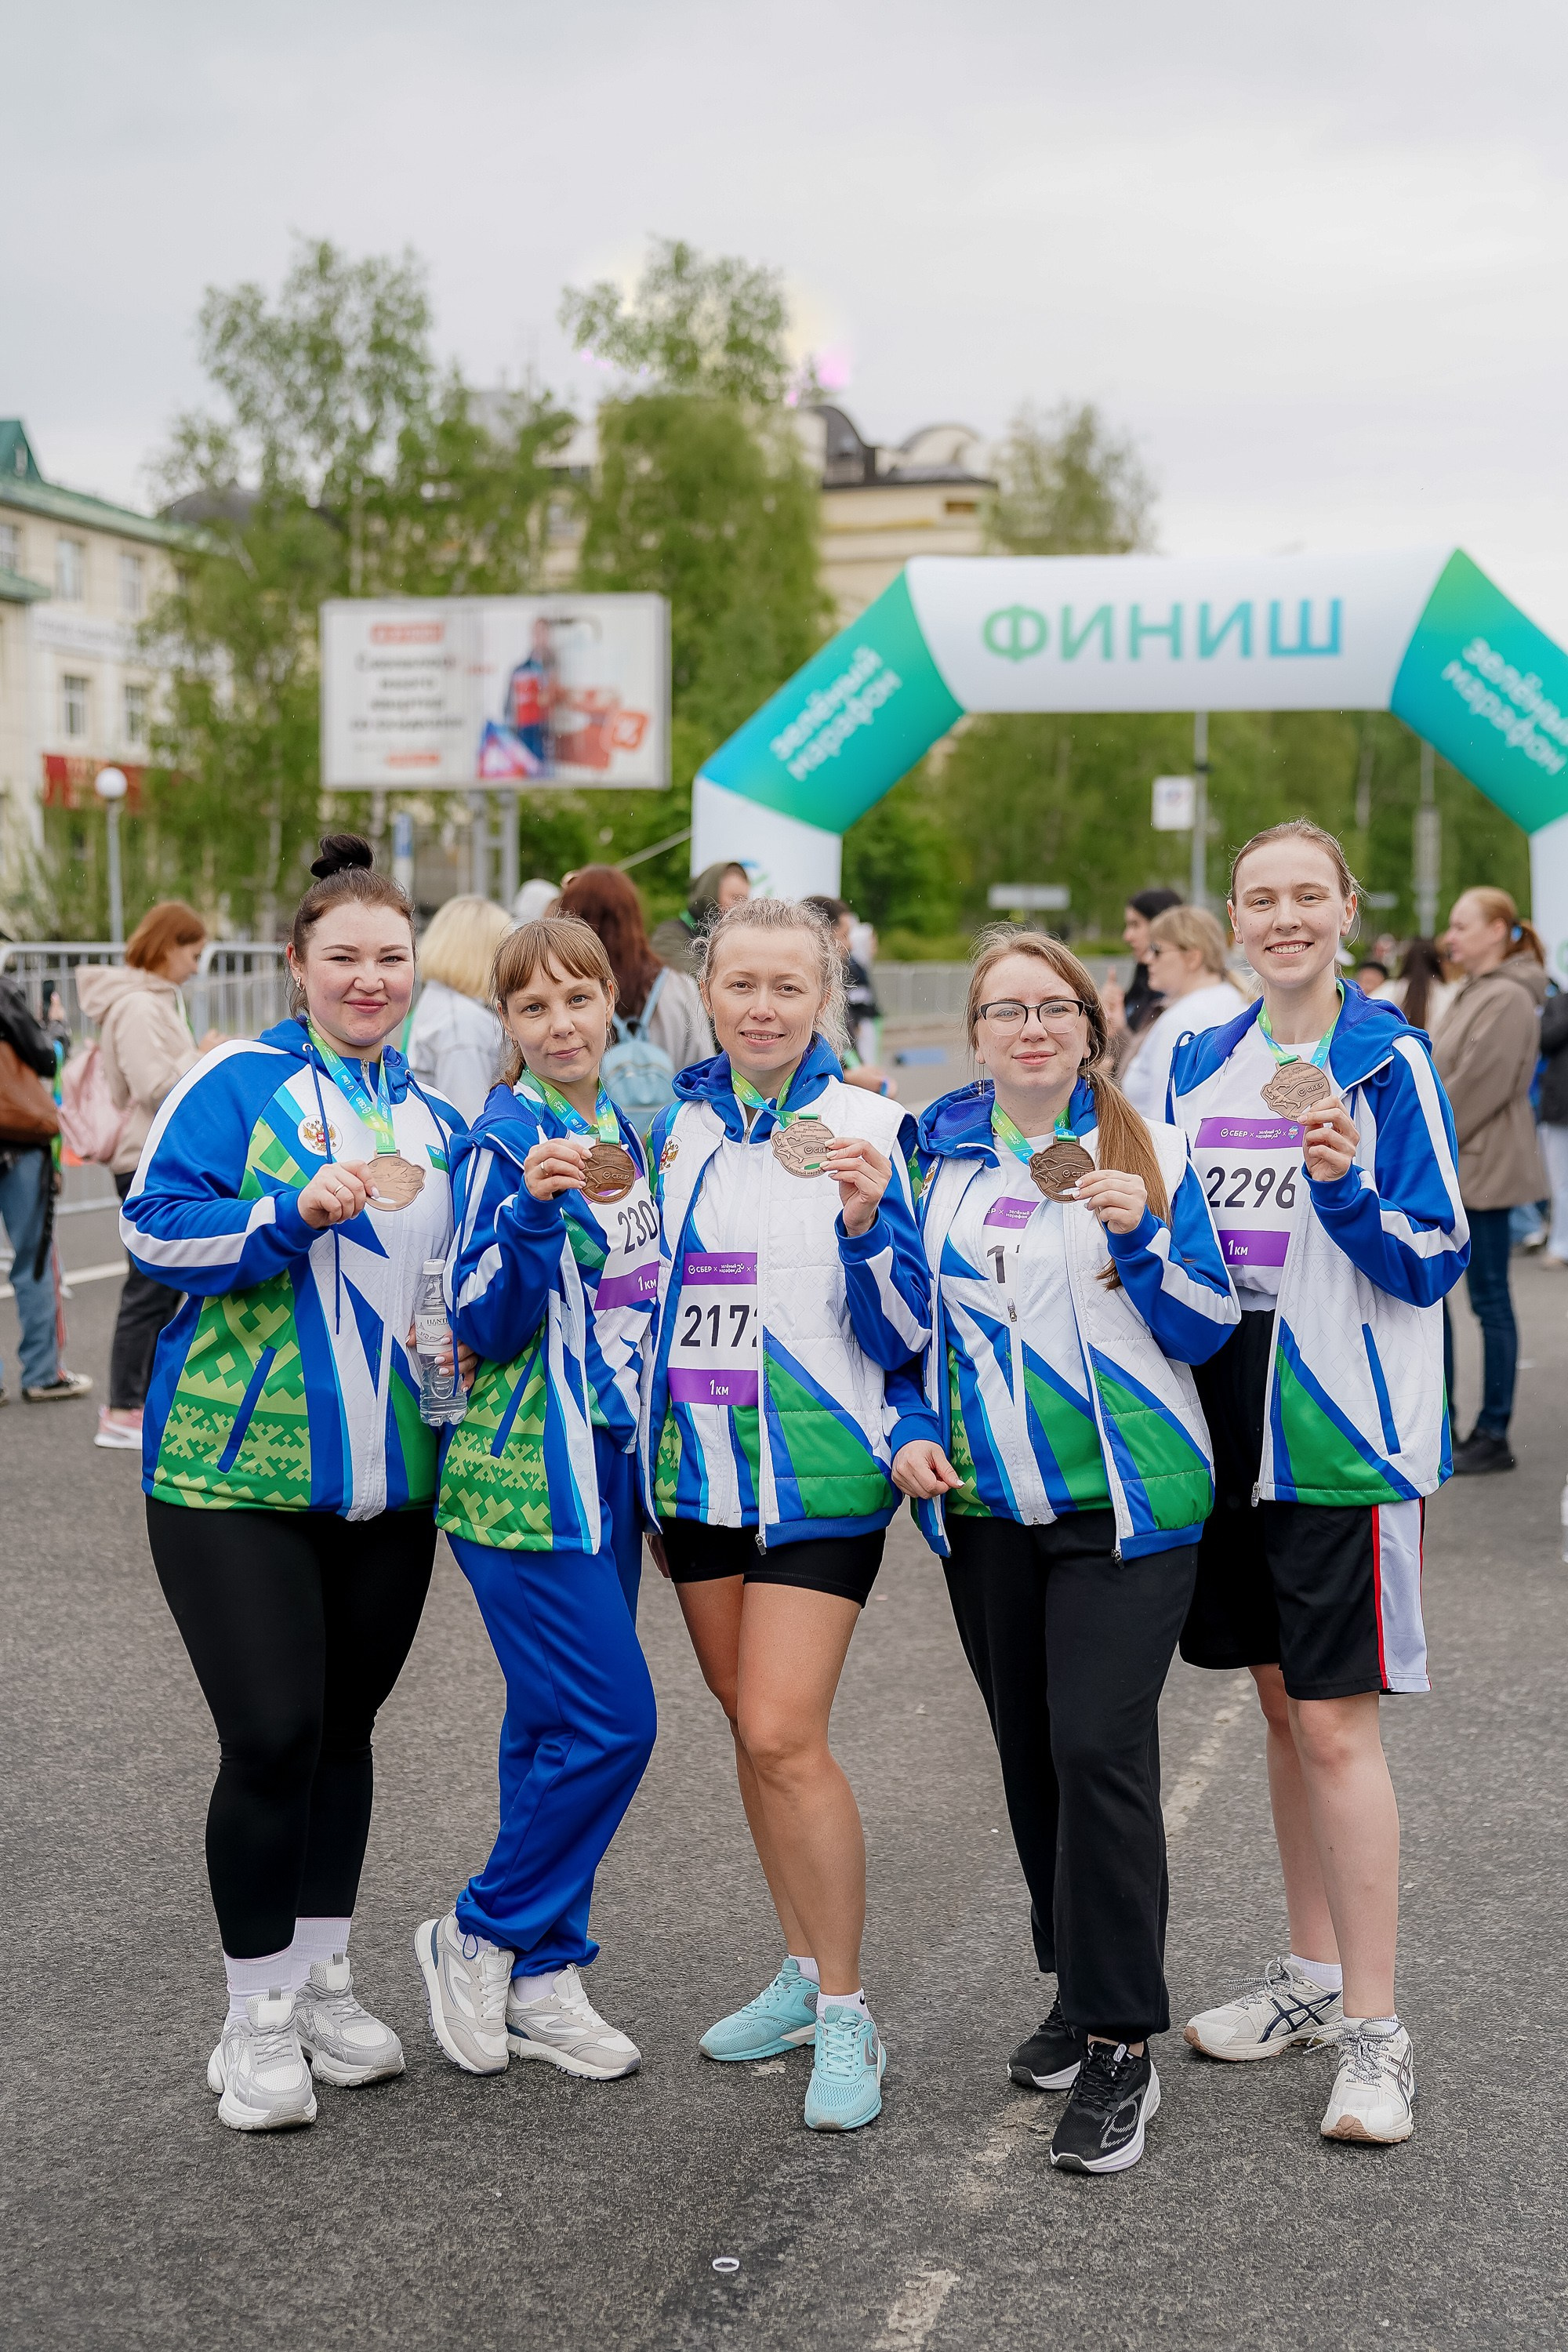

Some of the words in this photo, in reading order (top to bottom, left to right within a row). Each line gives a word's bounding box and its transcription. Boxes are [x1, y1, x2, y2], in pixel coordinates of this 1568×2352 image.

[982, 598, 1342, 663] ФИНИШ
[770, 644, 883, 762] зелёный
[786, 669, 903, 782] марафон
[1440, 659, 1567, 776] марафон
[1307, 1083, 1325, 1094] СБЕР
[1206, 1166, 1298, 1209] 2296
[617, 1194, 658, 1254] 230
[680, 1305, 757, 1348] 217
